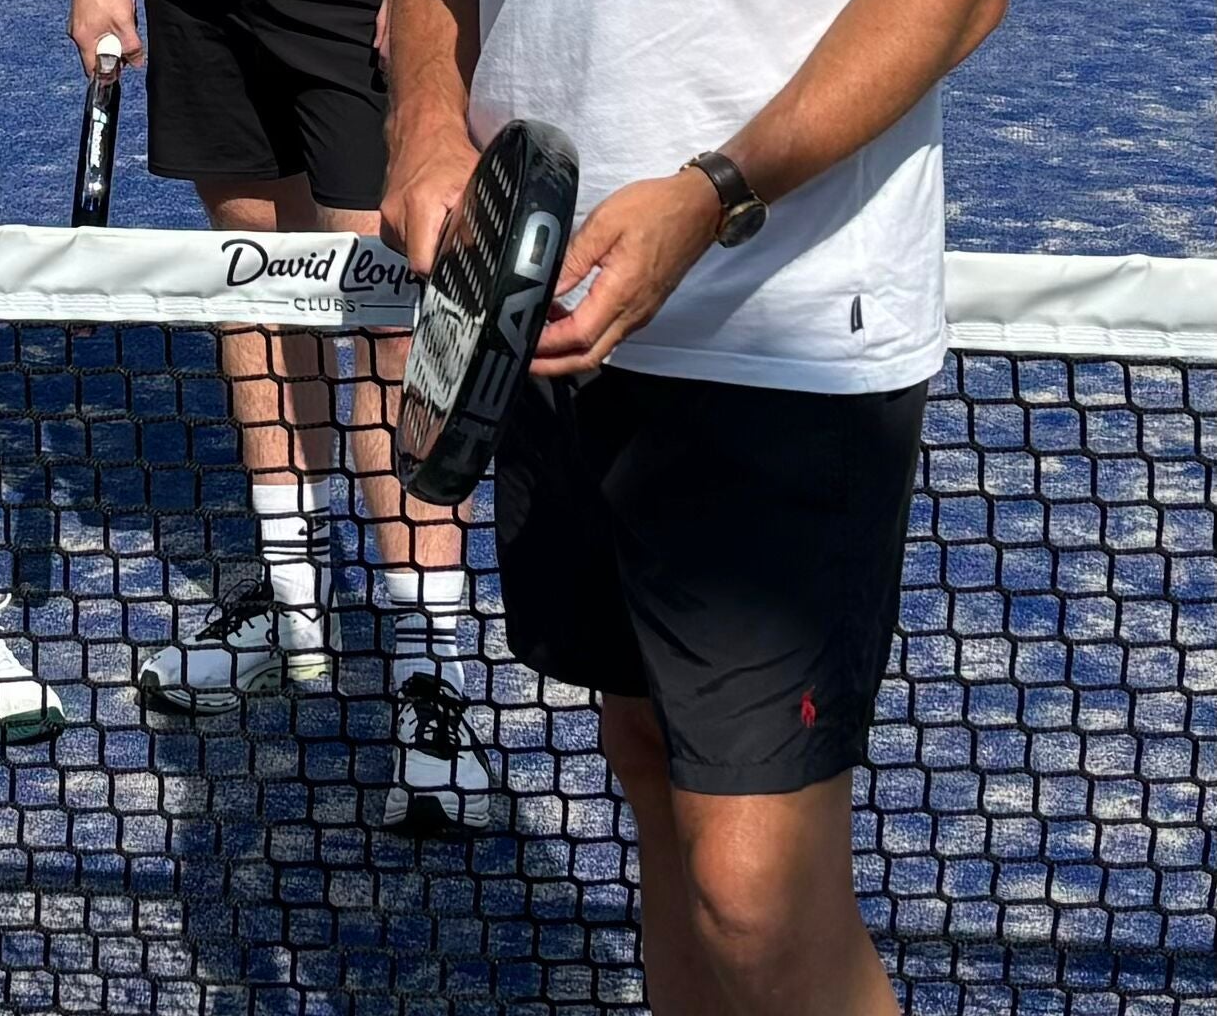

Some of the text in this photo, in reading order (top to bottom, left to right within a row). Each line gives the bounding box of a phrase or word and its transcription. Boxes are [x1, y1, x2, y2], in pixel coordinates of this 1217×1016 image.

[221, 238, 336, 287] David
[293, 297, 356, 313] CLUBS
[441, 210, 562, 474] HEAD
